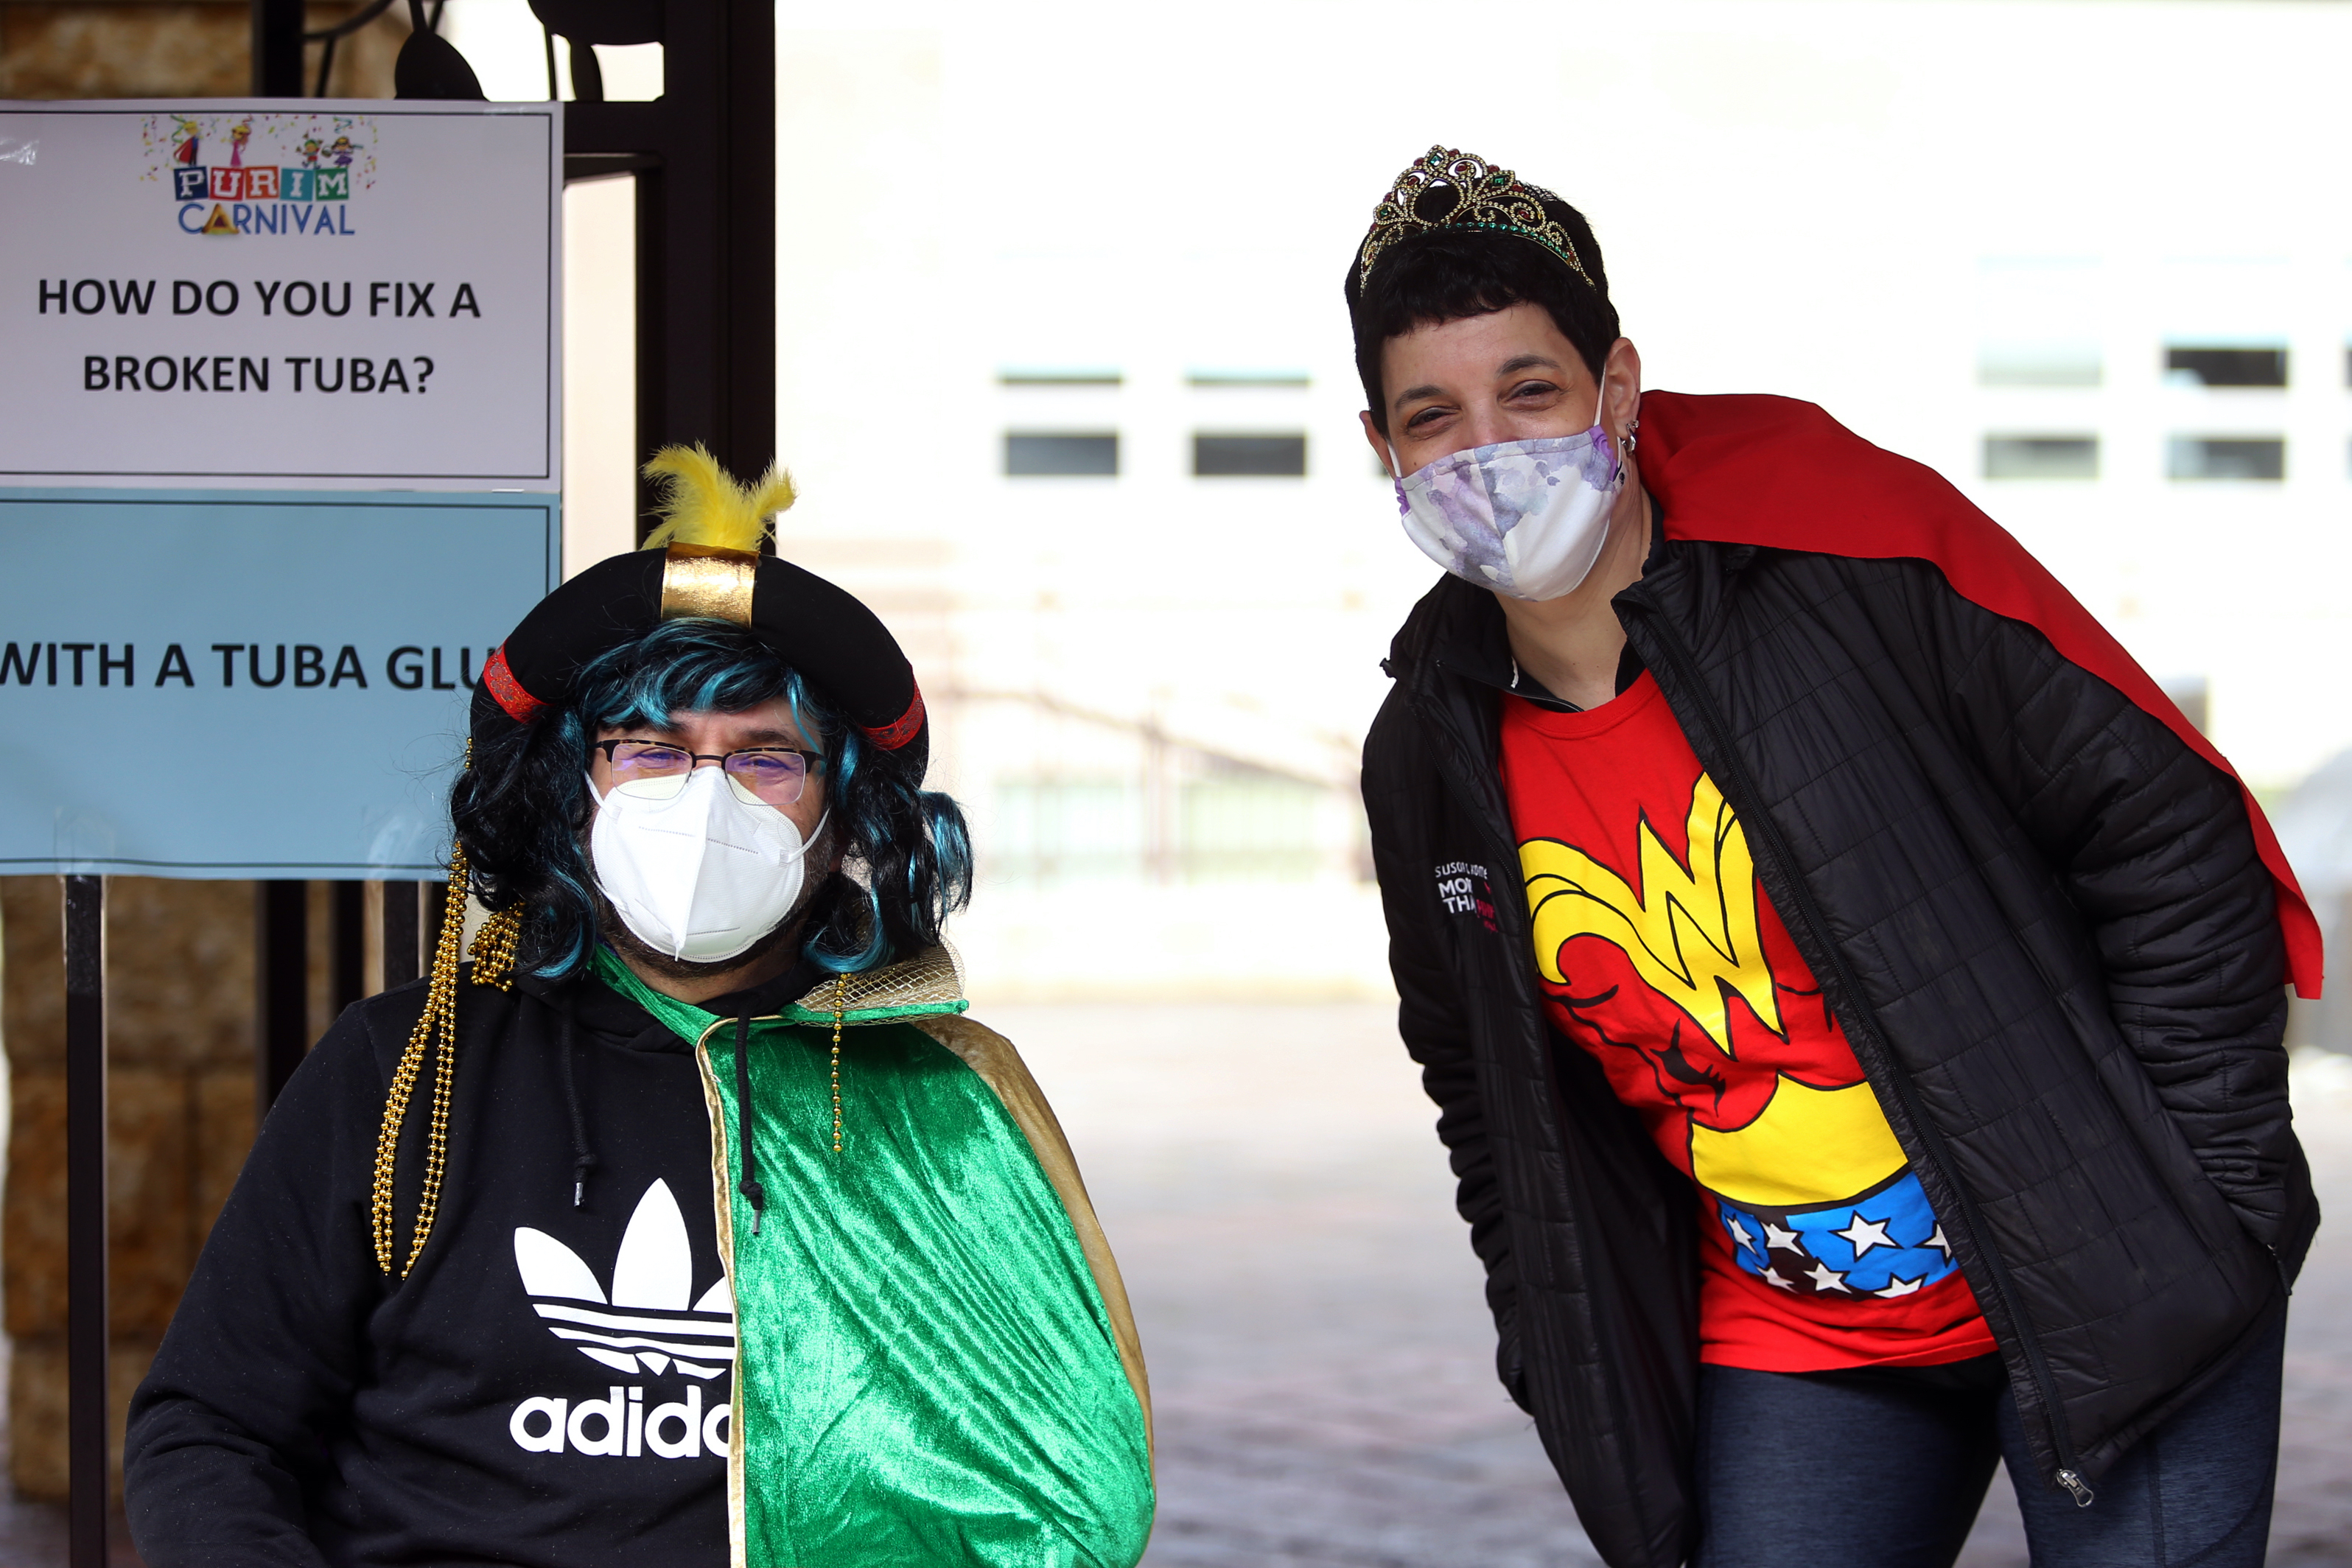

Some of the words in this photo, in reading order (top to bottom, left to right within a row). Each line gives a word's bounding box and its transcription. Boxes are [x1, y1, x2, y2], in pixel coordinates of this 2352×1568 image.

[177, 168, 349, 199] PURIM
[178, 203, 355, 235] CARNIVAL
[38, 279, 156, 315] HOW
[172, 280, 239, 316] DO
[253, 281, 351, 317] YOU
[370, 281, 435, 318] FIX
[449, 283, 481, 318] A
[84, 355, 269, 392] BROKEN
[284, 356, 434, 393] TUBA?
[0, 642, 134, 687] WITH
[155, 643, 195, 687] A
[211, 644, 368, 689] TUBA
[386, 645, 496, 690] GLU
[509, 1385, 731, 1459] adid
